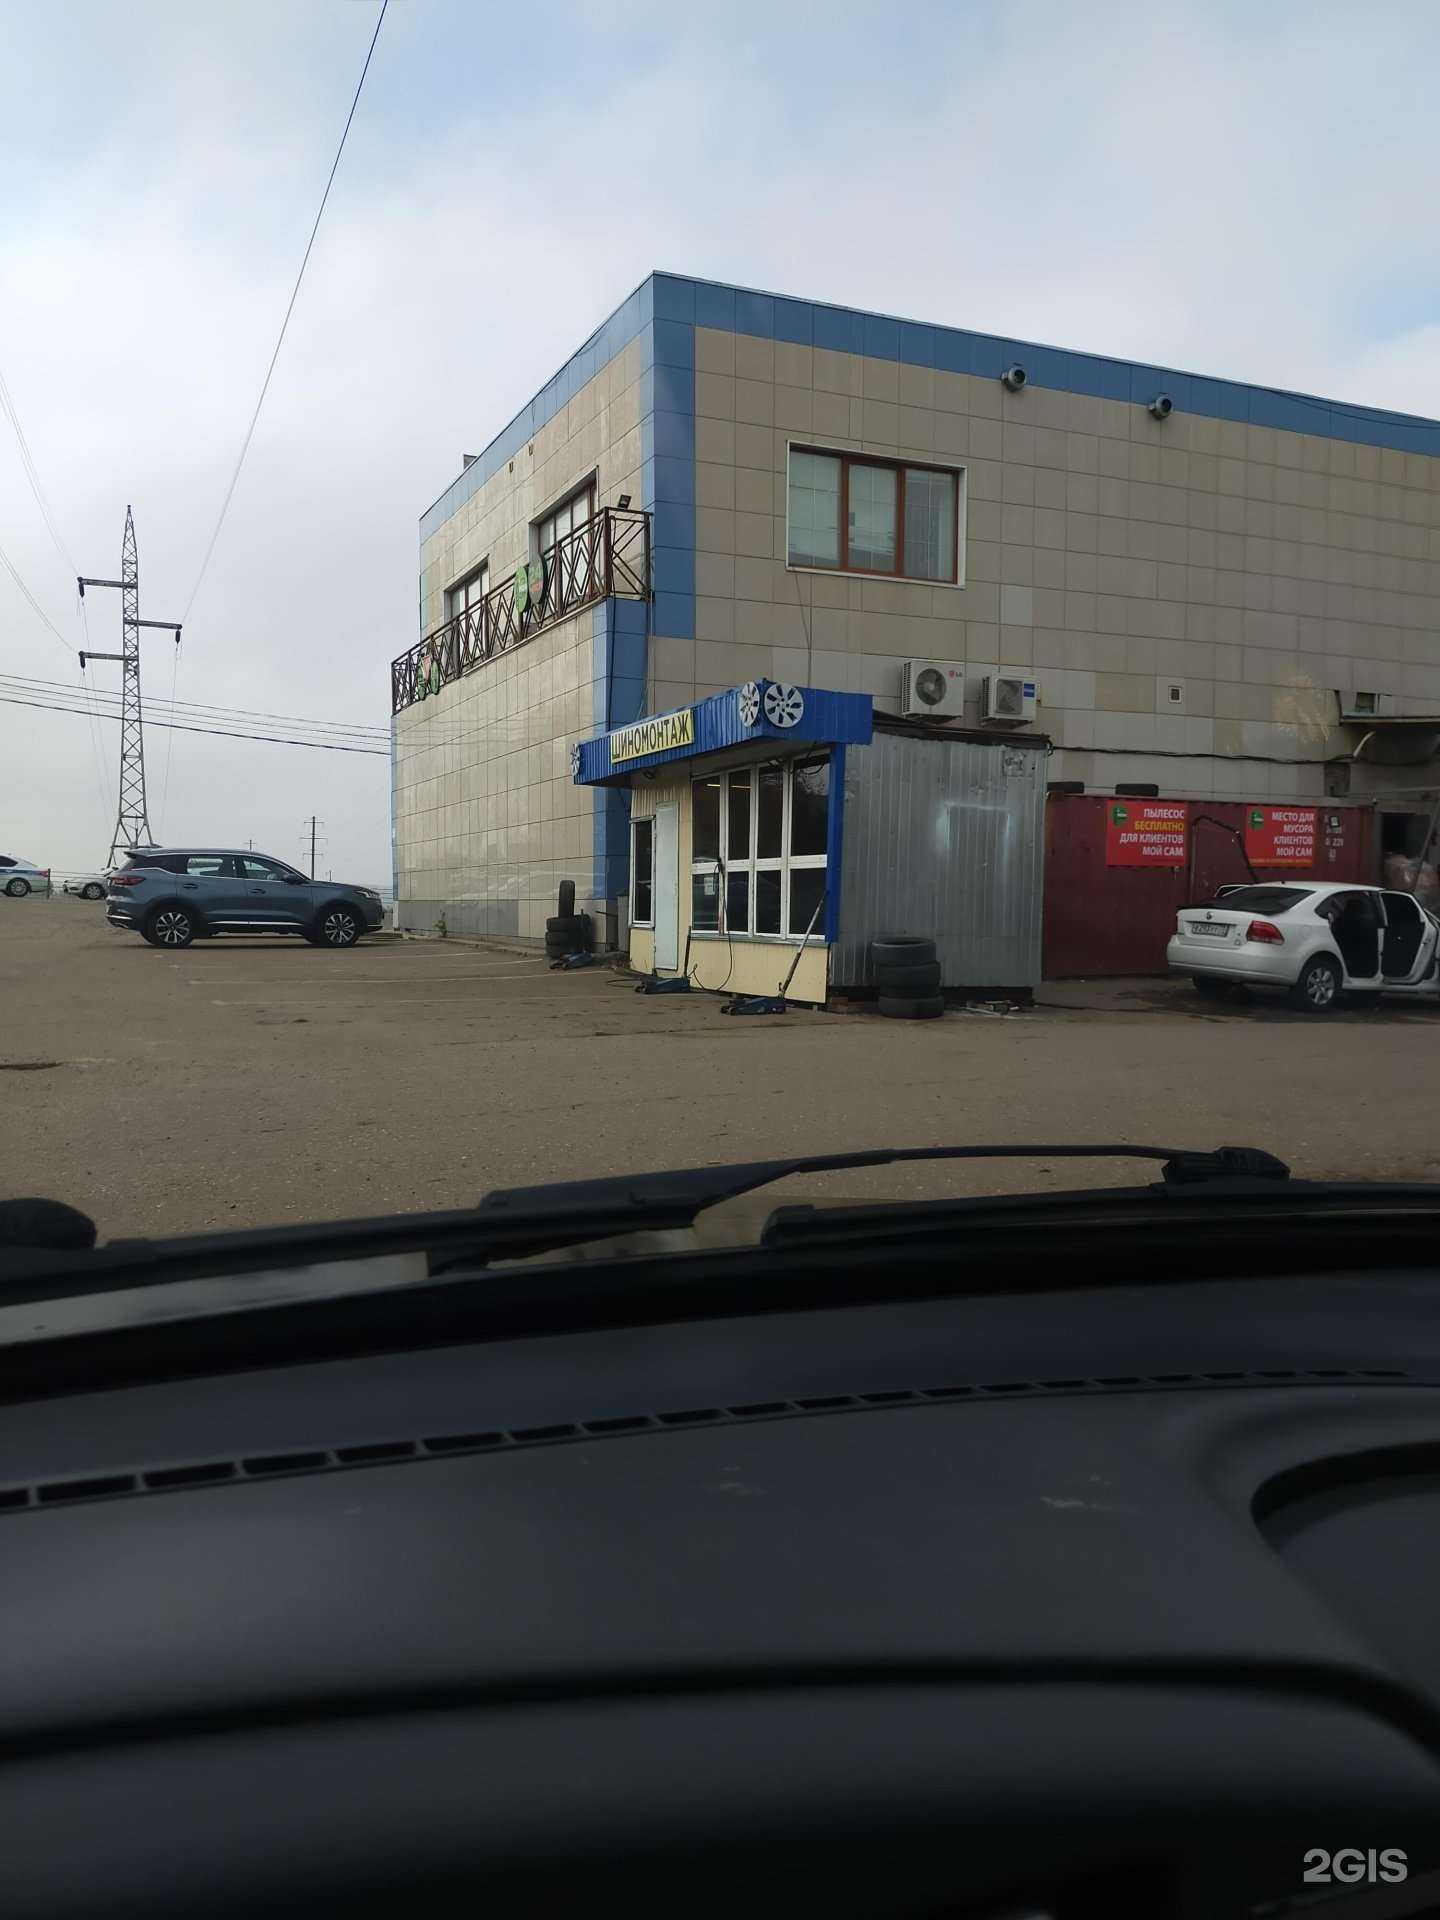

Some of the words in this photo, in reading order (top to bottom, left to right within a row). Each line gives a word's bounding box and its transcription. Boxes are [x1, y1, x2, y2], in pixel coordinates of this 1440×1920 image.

[611, 713, 690, 760] ШИНОМОНТАЖ
[1143, 808, 1185, 819] ПЫЛЕСОС
[1271, 812, 1298, 821] МЕСТО
[1299, 812, 1314, 823] ДЛЯ
[1134, 821, 1185, 831] БЕСПЛАТНО
[1283, 824, 1314, 833] МУСОРА
[1119, 833, 1138, 844] ДЛЯ
[1139, 834, 1184, 844] КЛИЕНТОВ
[1273, 836, 1313, 845] КЛИЕНТОВ
[1142, 845, 1163, 856] МОЙ
[1164, 847, 1184, 856] САМ
[1276, 847, 1295, 856] МОЙ
[1295, 848, 1313, 856] САМ
